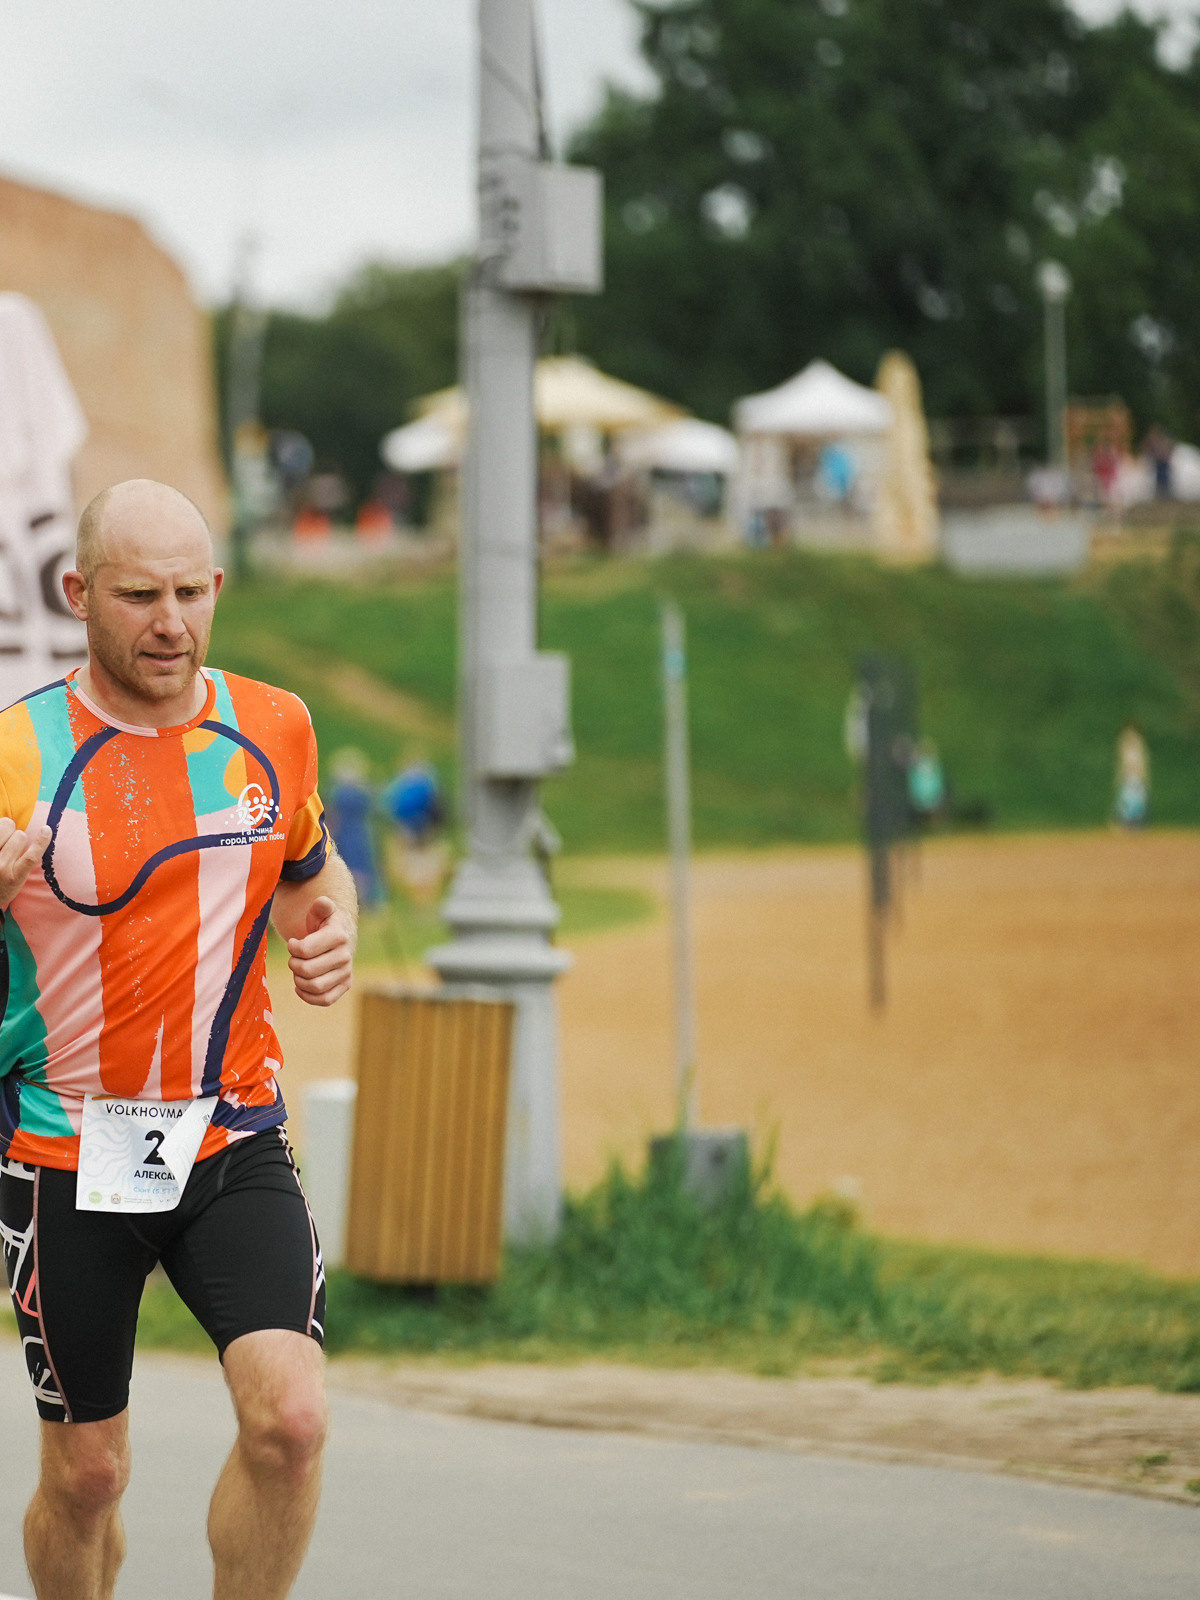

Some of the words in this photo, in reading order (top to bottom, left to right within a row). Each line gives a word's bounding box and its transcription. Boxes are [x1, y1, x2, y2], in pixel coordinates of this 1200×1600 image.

[220, 836, 247, 846] город
[248, 835, 268, 843] моих
[105, 1103, 186, 1119] VOLKHOVMA
[134, 1169, 176, 1181] АЛЕКСА
